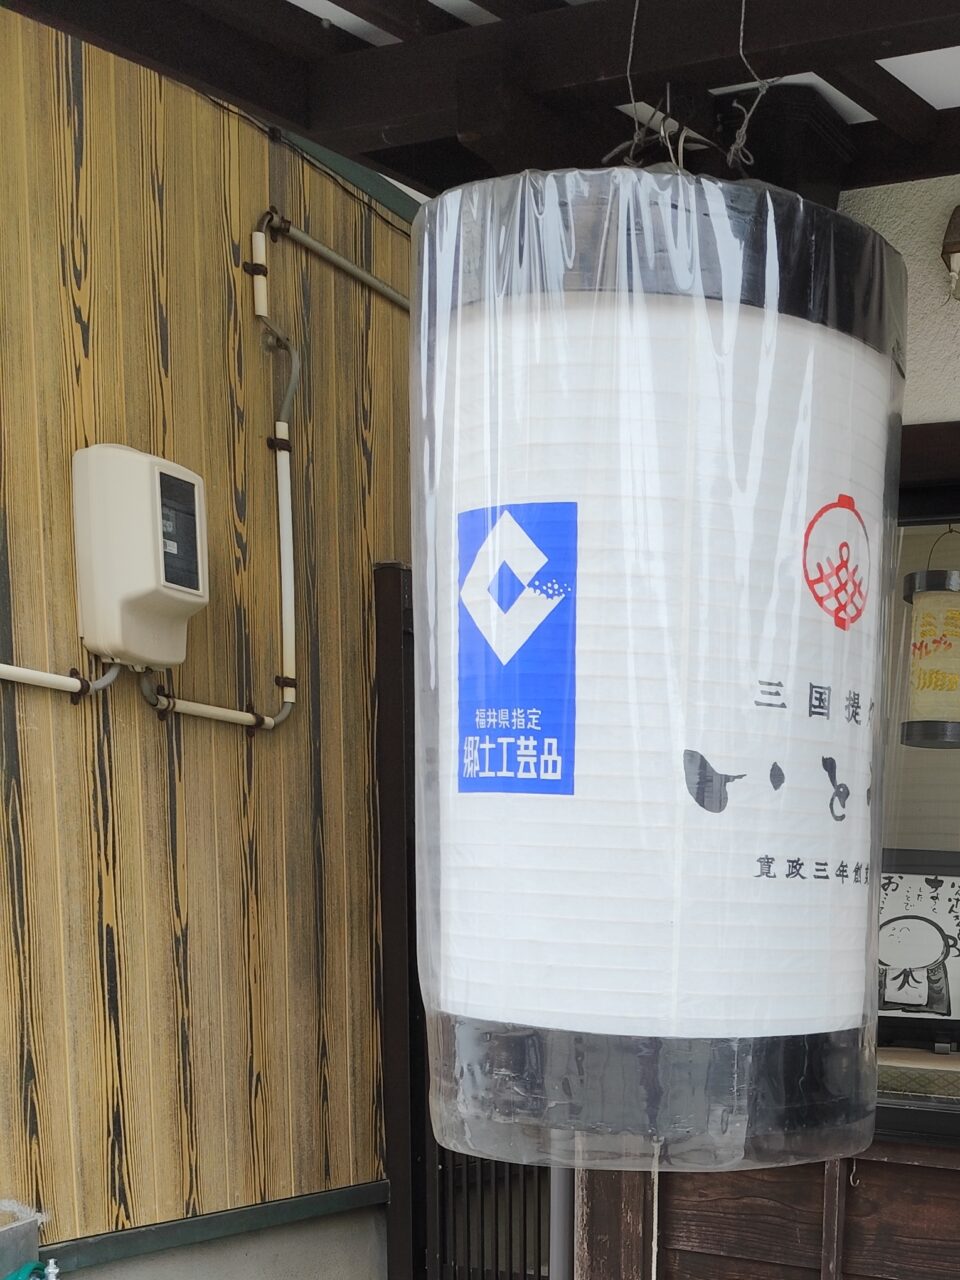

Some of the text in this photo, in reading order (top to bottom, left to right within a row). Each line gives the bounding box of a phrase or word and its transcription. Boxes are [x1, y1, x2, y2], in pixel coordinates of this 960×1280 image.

[475, 707, 542, 731] 福井県指定
[462, 736, 562, 781] 郷土工芸品
